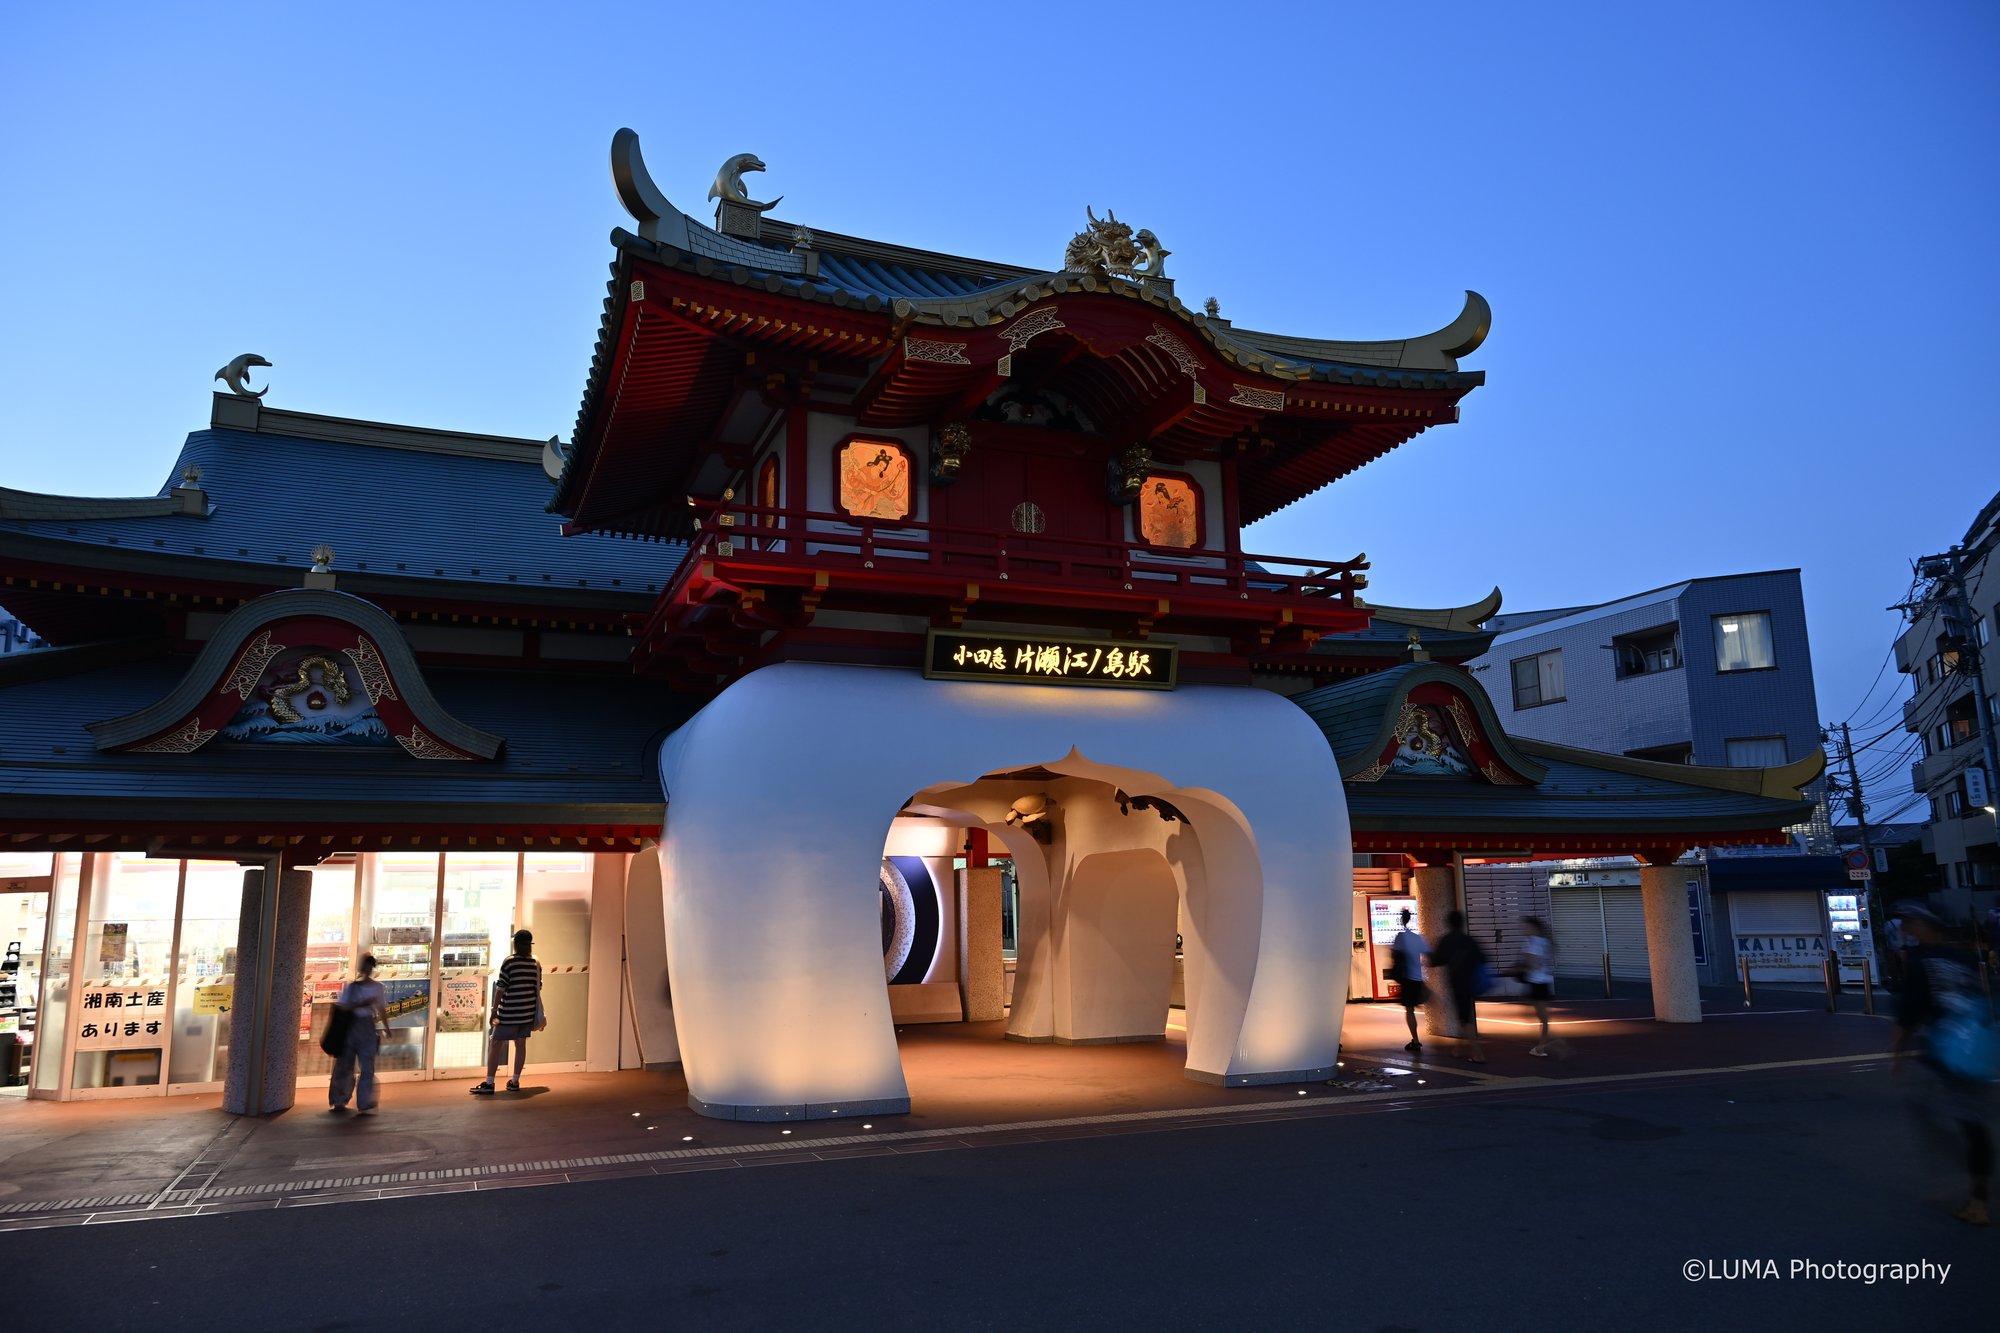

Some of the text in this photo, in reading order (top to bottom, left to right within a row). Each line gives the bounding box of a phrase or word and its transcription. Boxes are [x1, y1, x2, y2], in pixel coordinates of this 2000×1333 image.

[953, 644, 1152, 678] 小田急 片瀬江ノ島駅
[83, 991, 166, 1009] 湘南土産
[81, 1020, 163, 1038] あります
